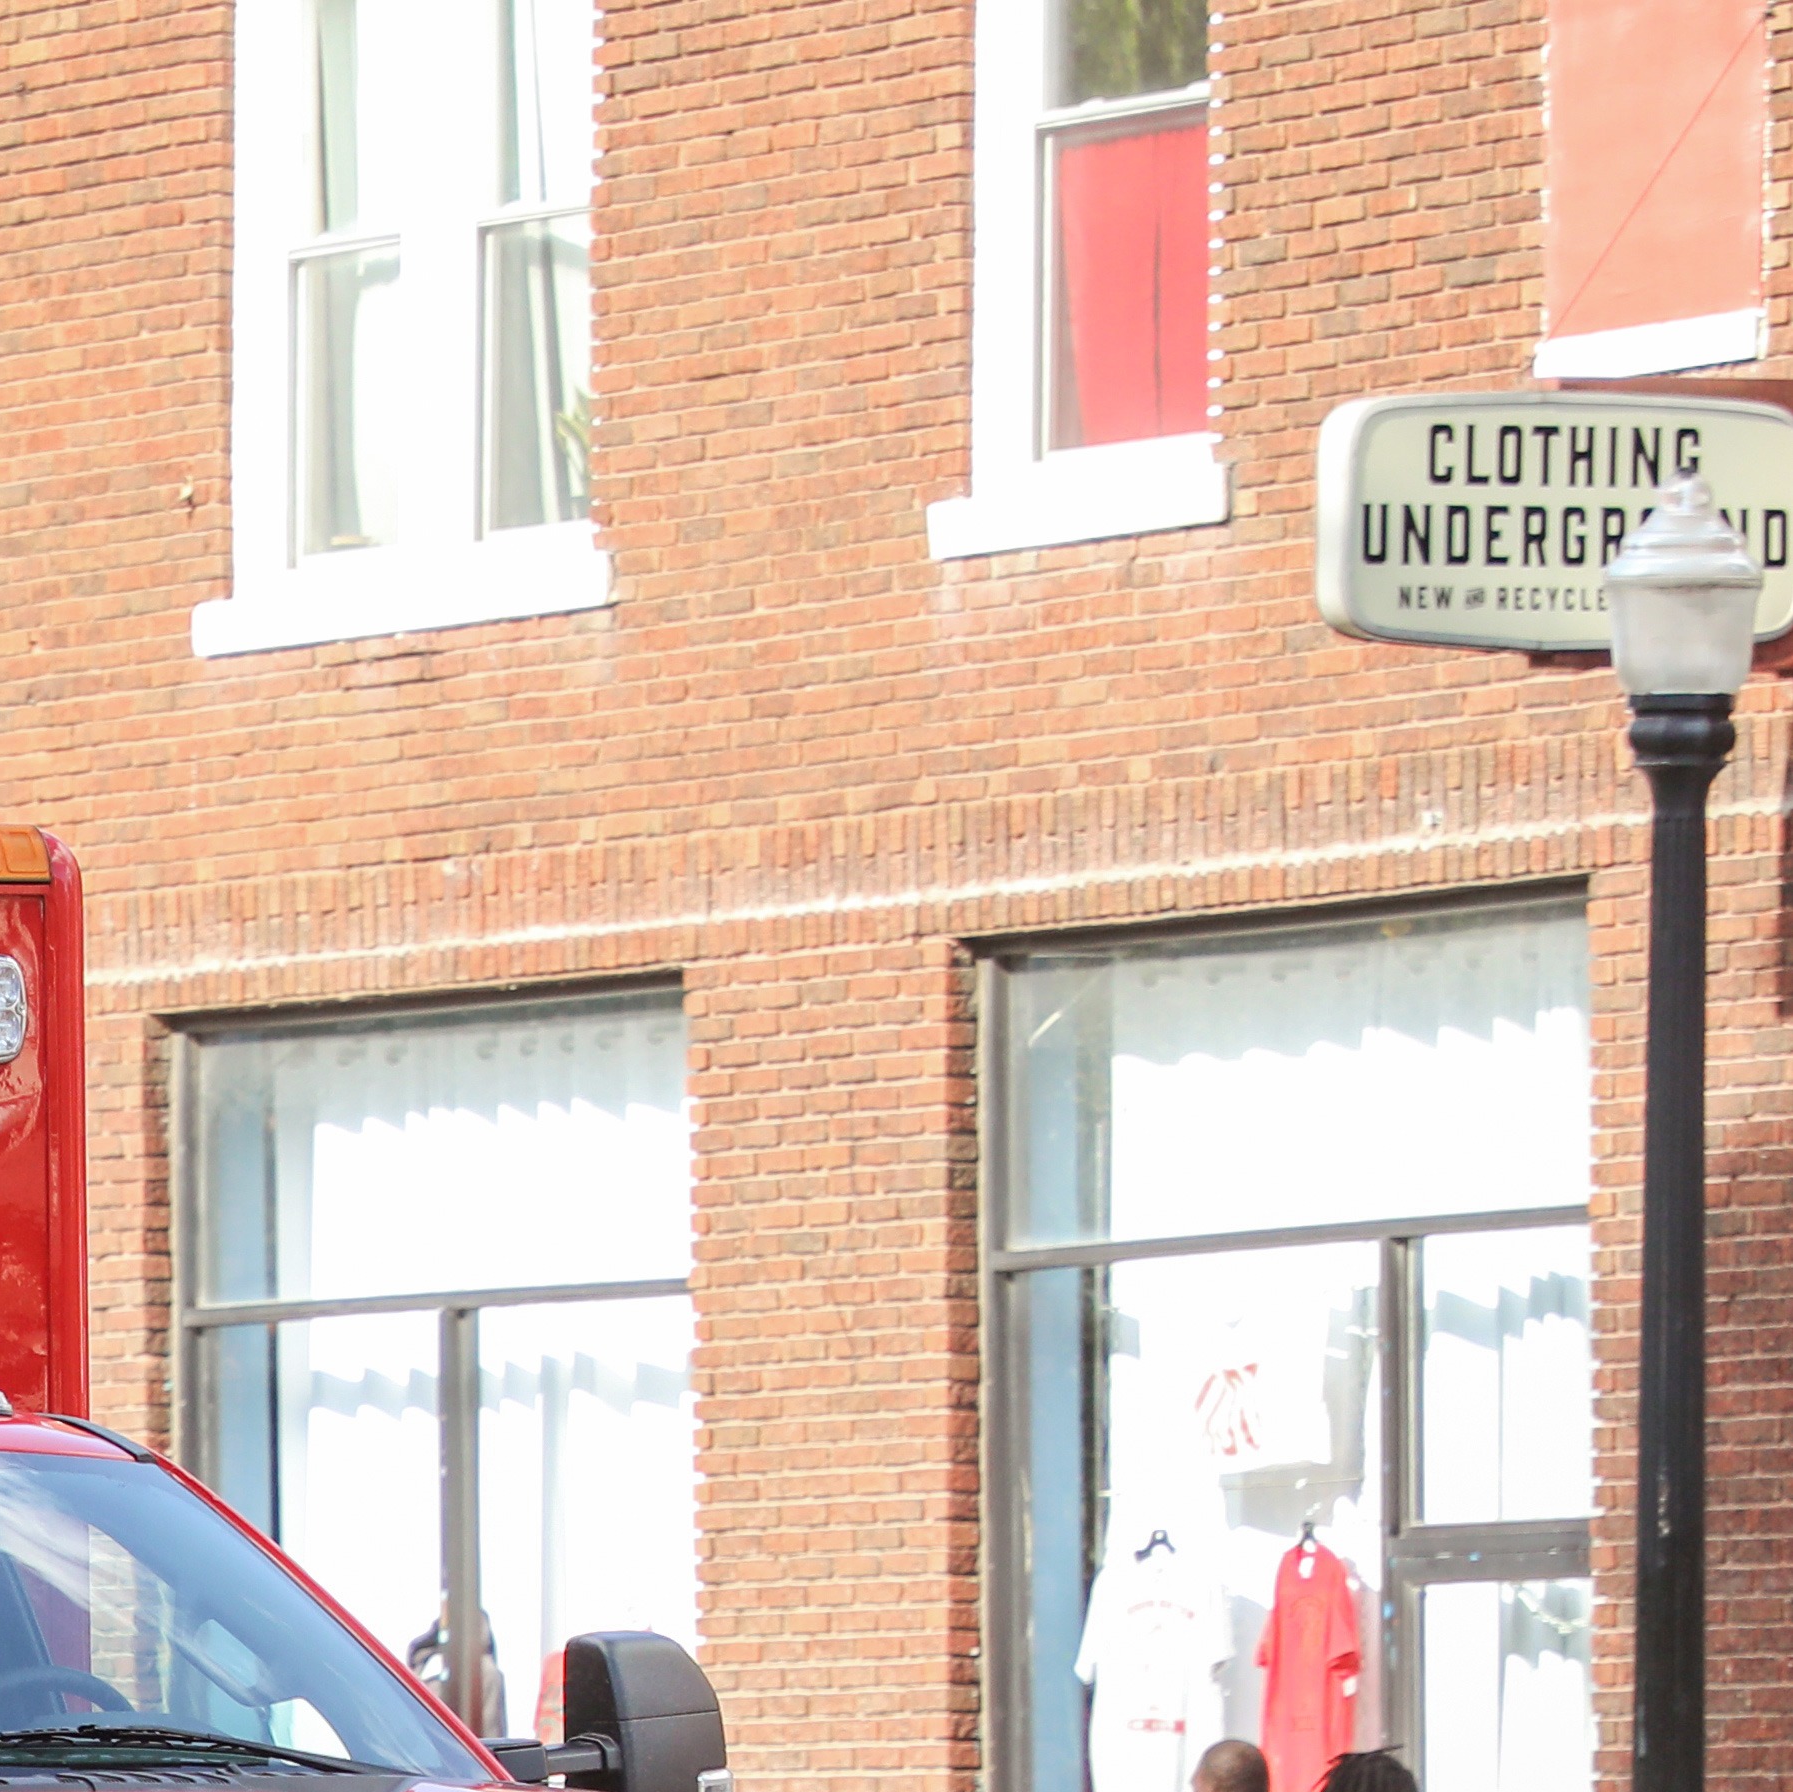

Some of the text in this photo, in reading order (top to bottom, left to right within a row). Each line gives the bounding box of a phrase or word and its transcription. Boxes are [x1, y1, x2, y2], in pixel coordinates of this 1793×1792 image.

[1428, 424, 1701, 487] CLOTHING
[1362, 503, 1789, 568] UNDERGRD
[1399, 586, 1453, 610] NEW
[1498, 587, 1609, 611] RECYCLE
